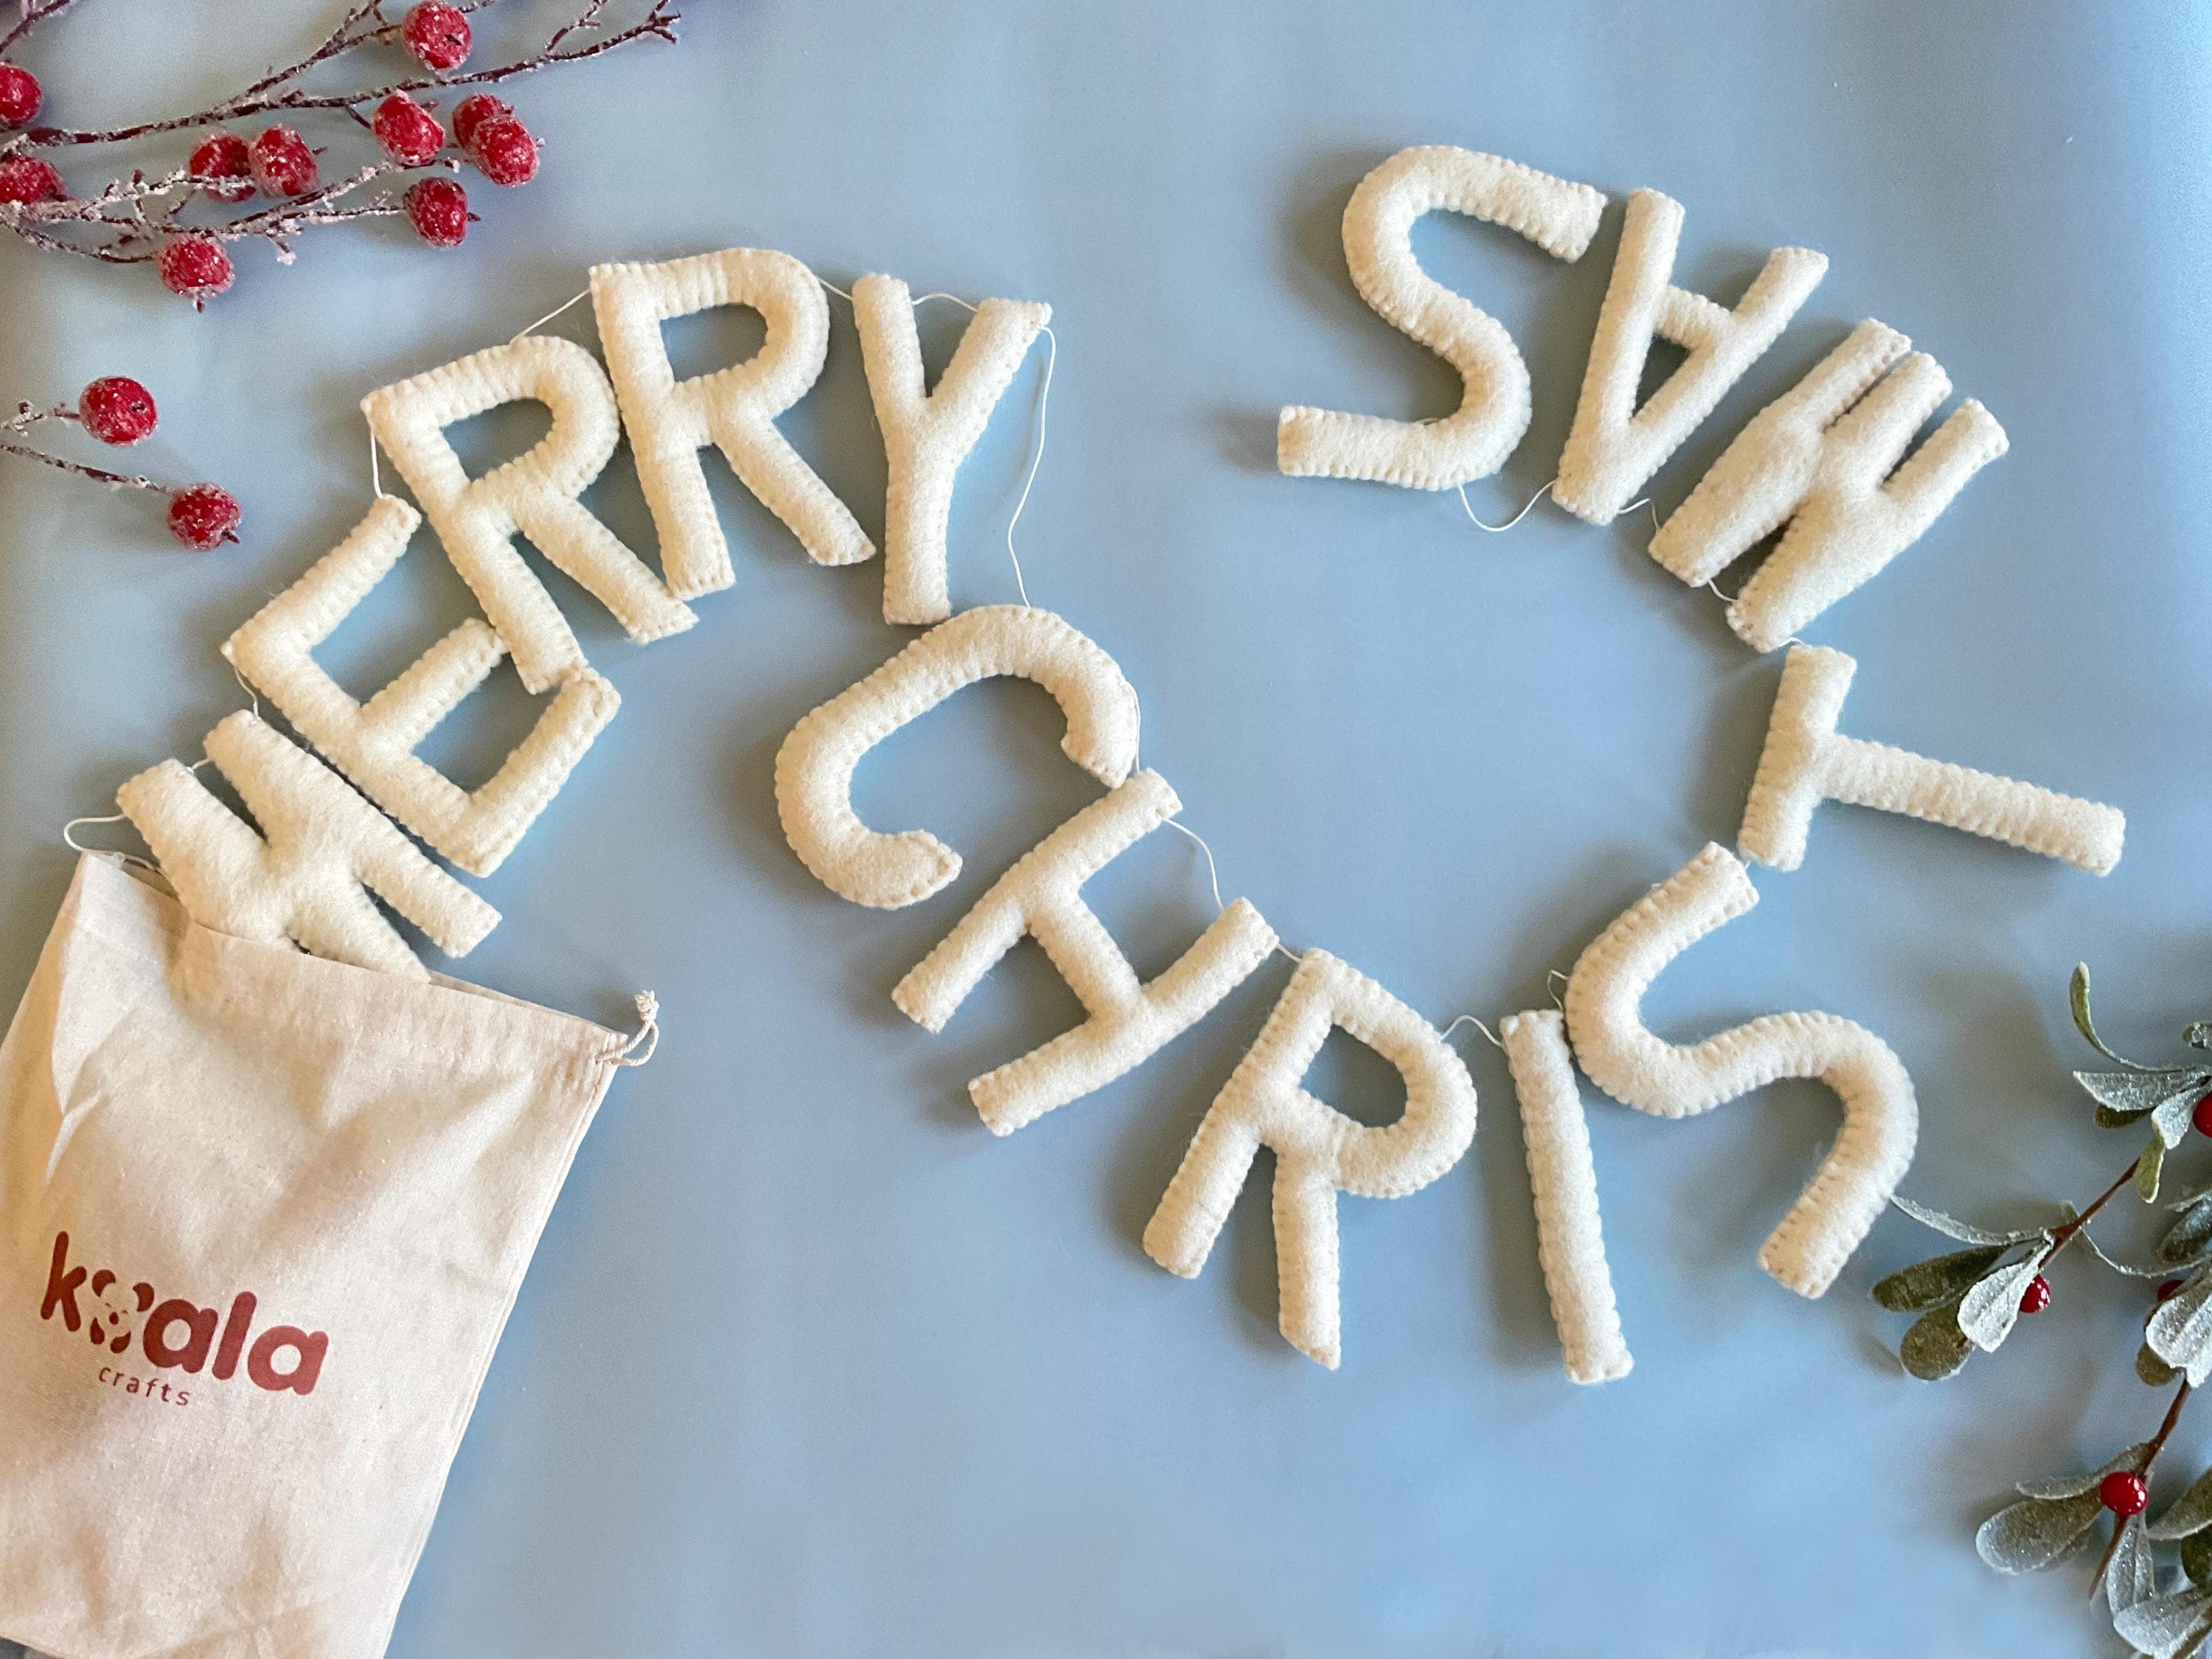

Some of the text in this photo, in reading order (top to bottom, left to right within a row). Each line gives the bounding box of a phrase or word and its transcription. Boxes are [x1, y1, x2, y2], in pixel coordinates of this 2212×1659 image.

[116, 145, 2126, 1383] MERRY CHRISTMAS
[99, 1366, 191, 1406] crafts
